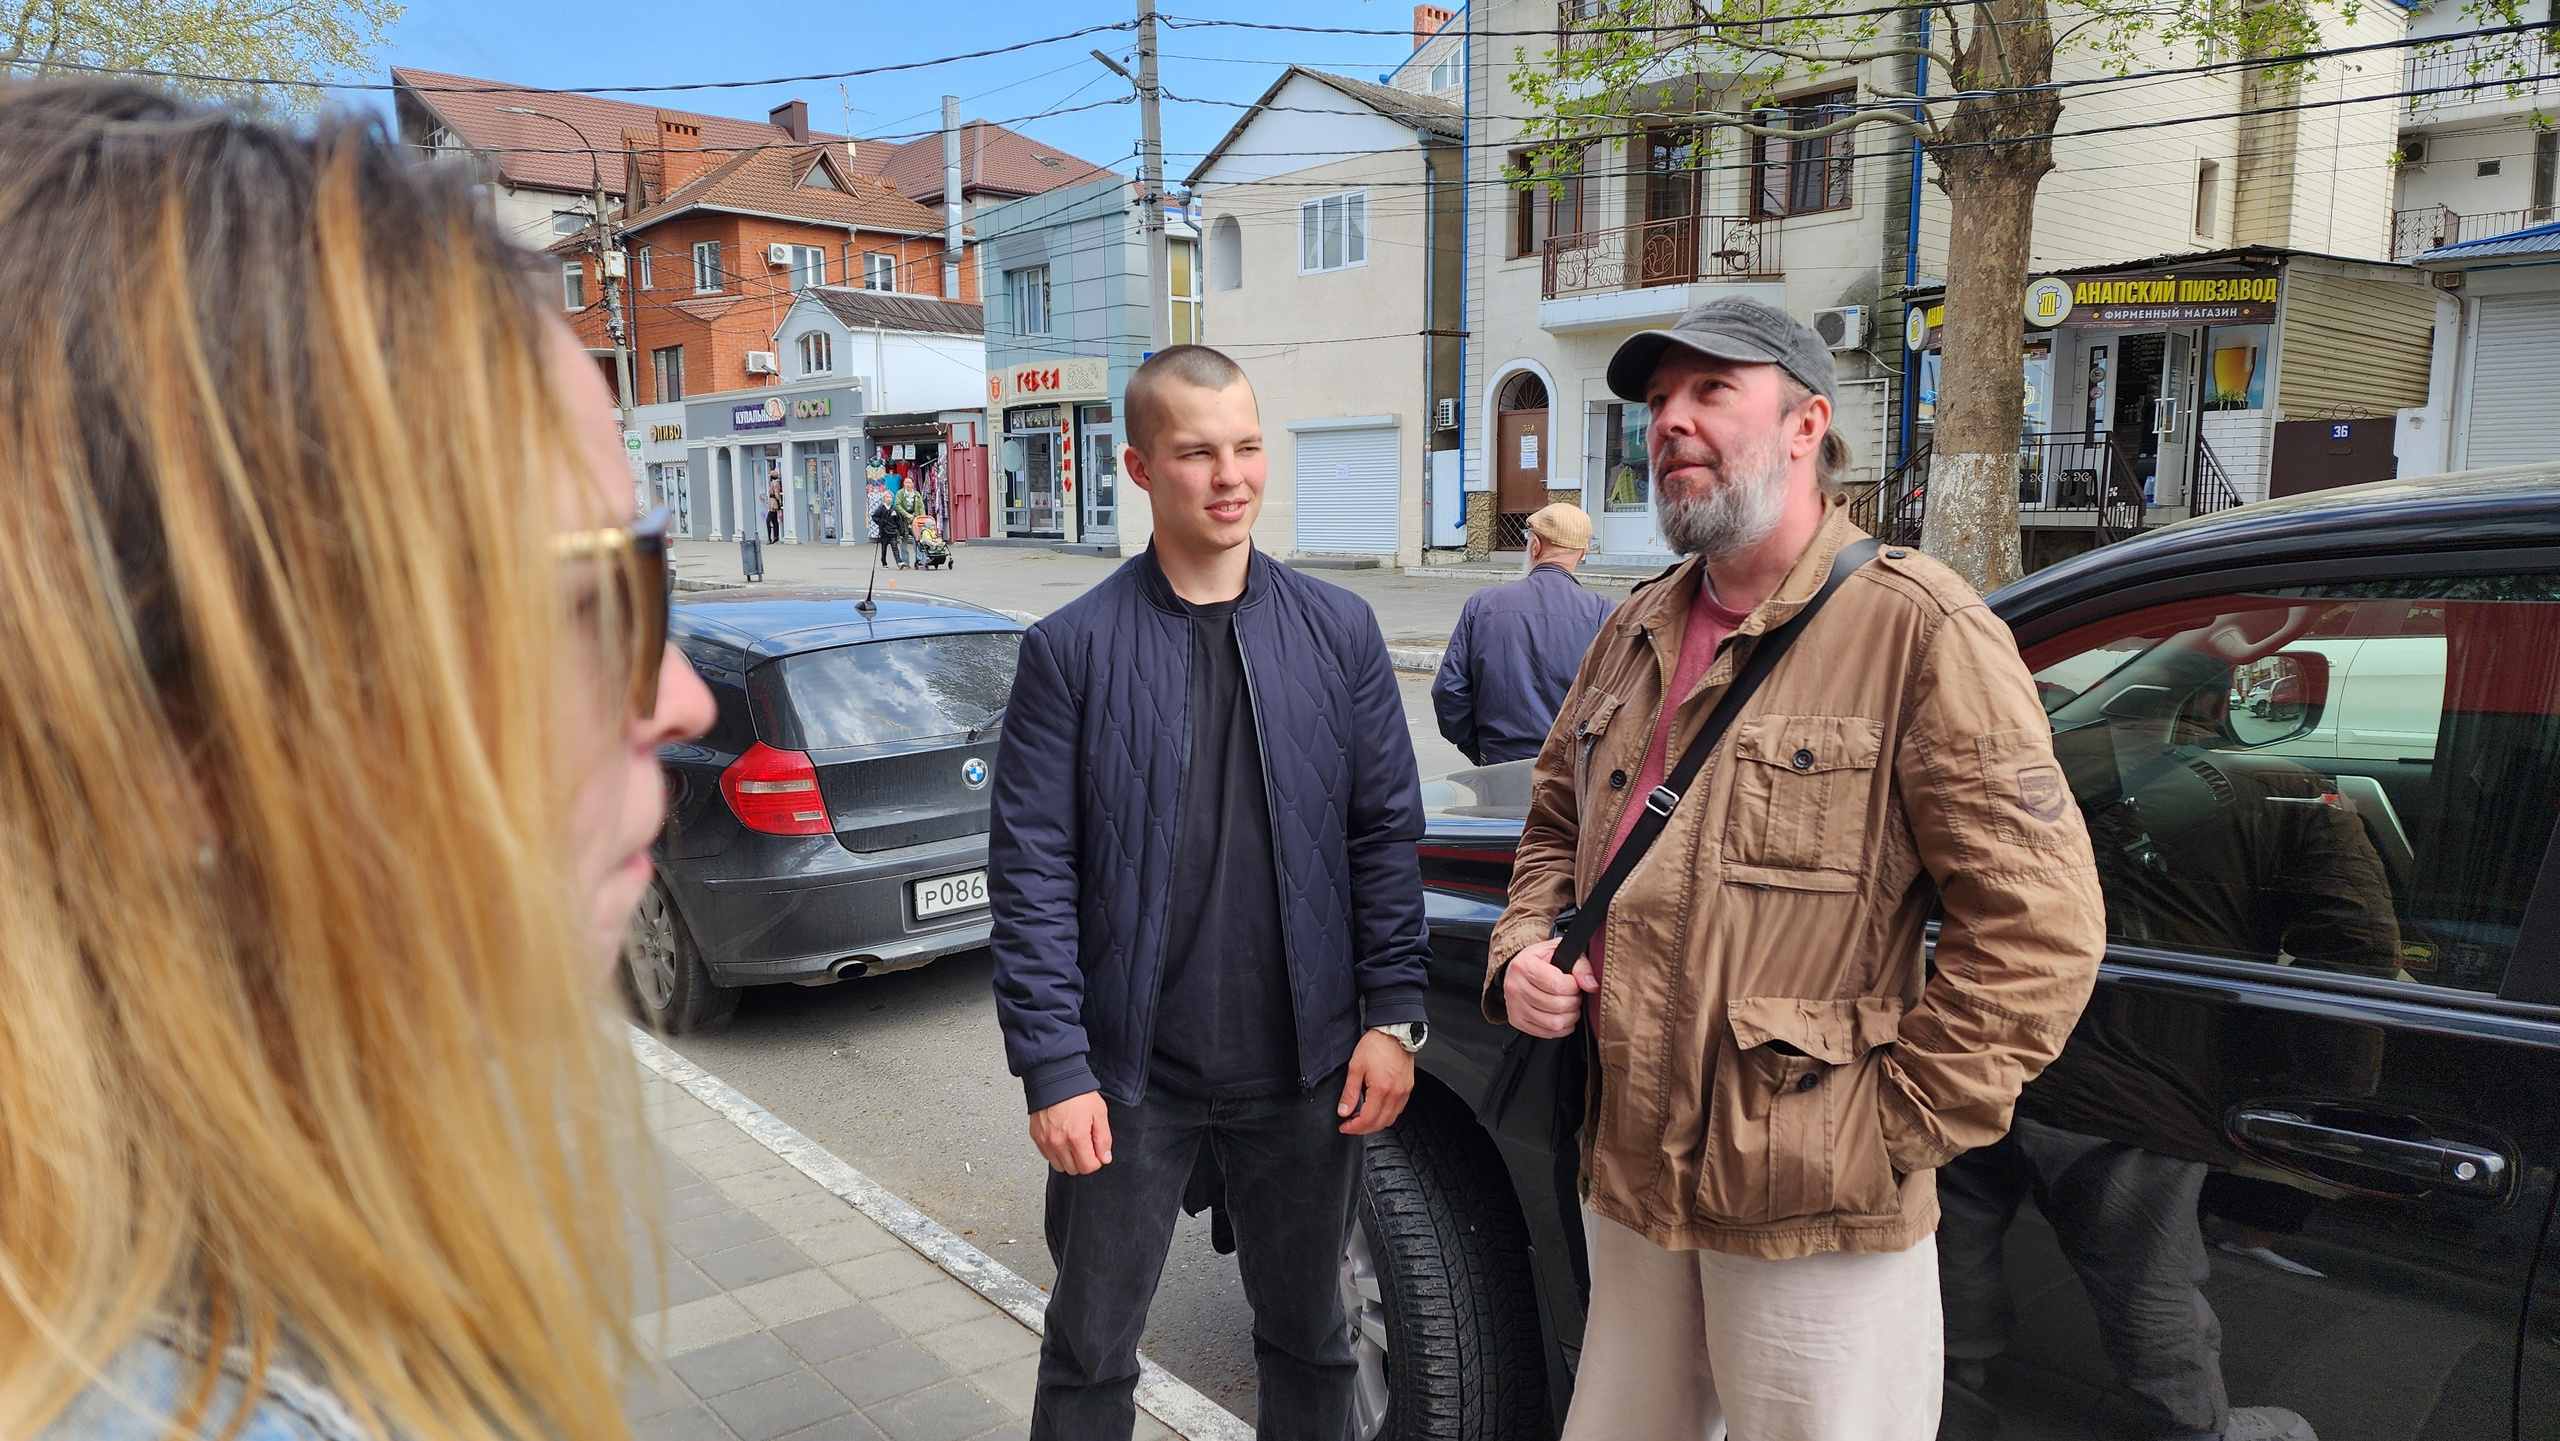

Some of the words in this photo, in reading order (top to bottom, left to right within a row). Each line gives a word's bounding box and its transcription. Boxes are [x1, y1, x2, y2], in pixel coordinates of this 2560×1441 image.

[2074, 274, 2176, 304] АНАПСКИЙ
[2178, 278, 2277, 303] ПИВЗАВОД
[2104, 307, 2180, 320] ФИРМЕННЫЙ
[2184, 308, 2238, 318] МАГАЗИН
[1016, 368, 1059, 393] ГЕБЕЯ
[793, 397, 831, 418] КОСЫ
[656, 424, 682, 441] ПИВО
[2333, 425, 2349, 438] 36
